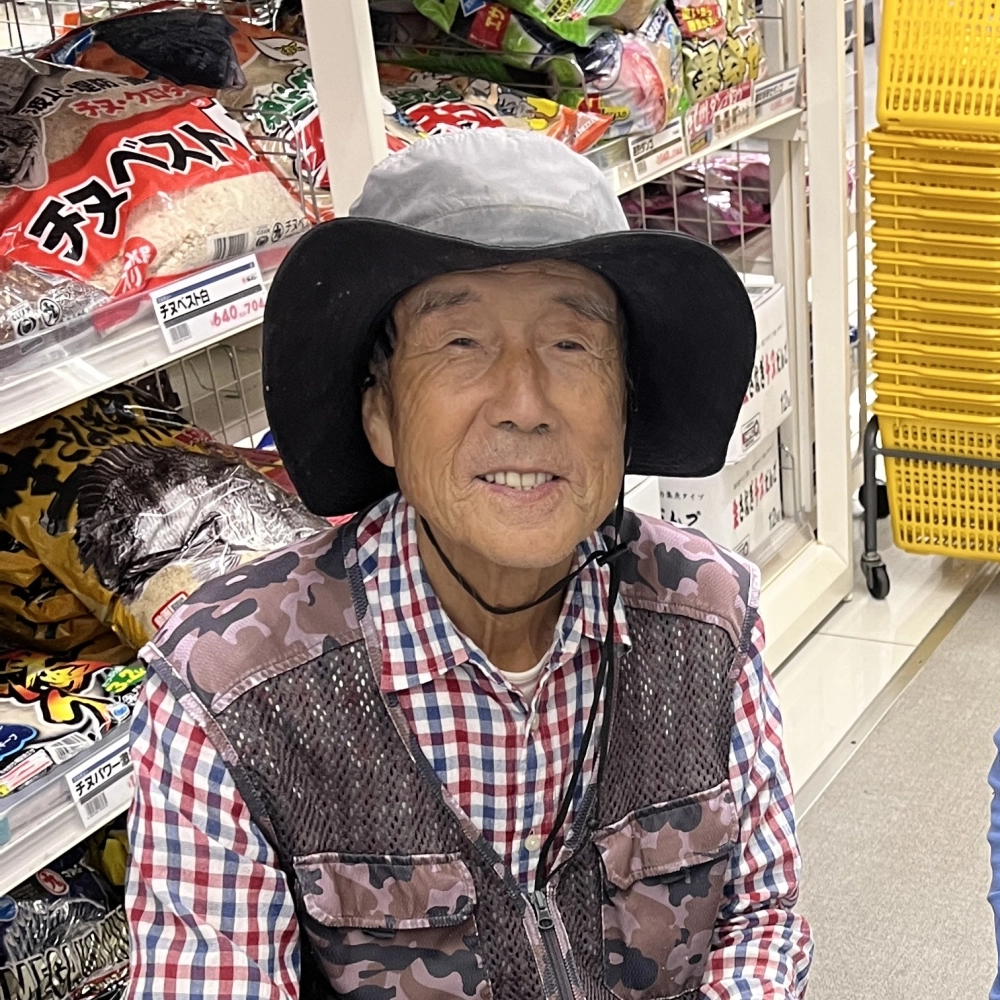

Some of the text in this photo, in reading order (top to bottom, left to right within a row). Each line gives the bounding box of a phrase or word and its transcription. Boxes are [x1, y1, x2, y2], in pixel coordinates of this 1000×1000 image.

[27, 123, 234, 263] チヌベスト
[159, 289, 210, 319] チヌベスト白
